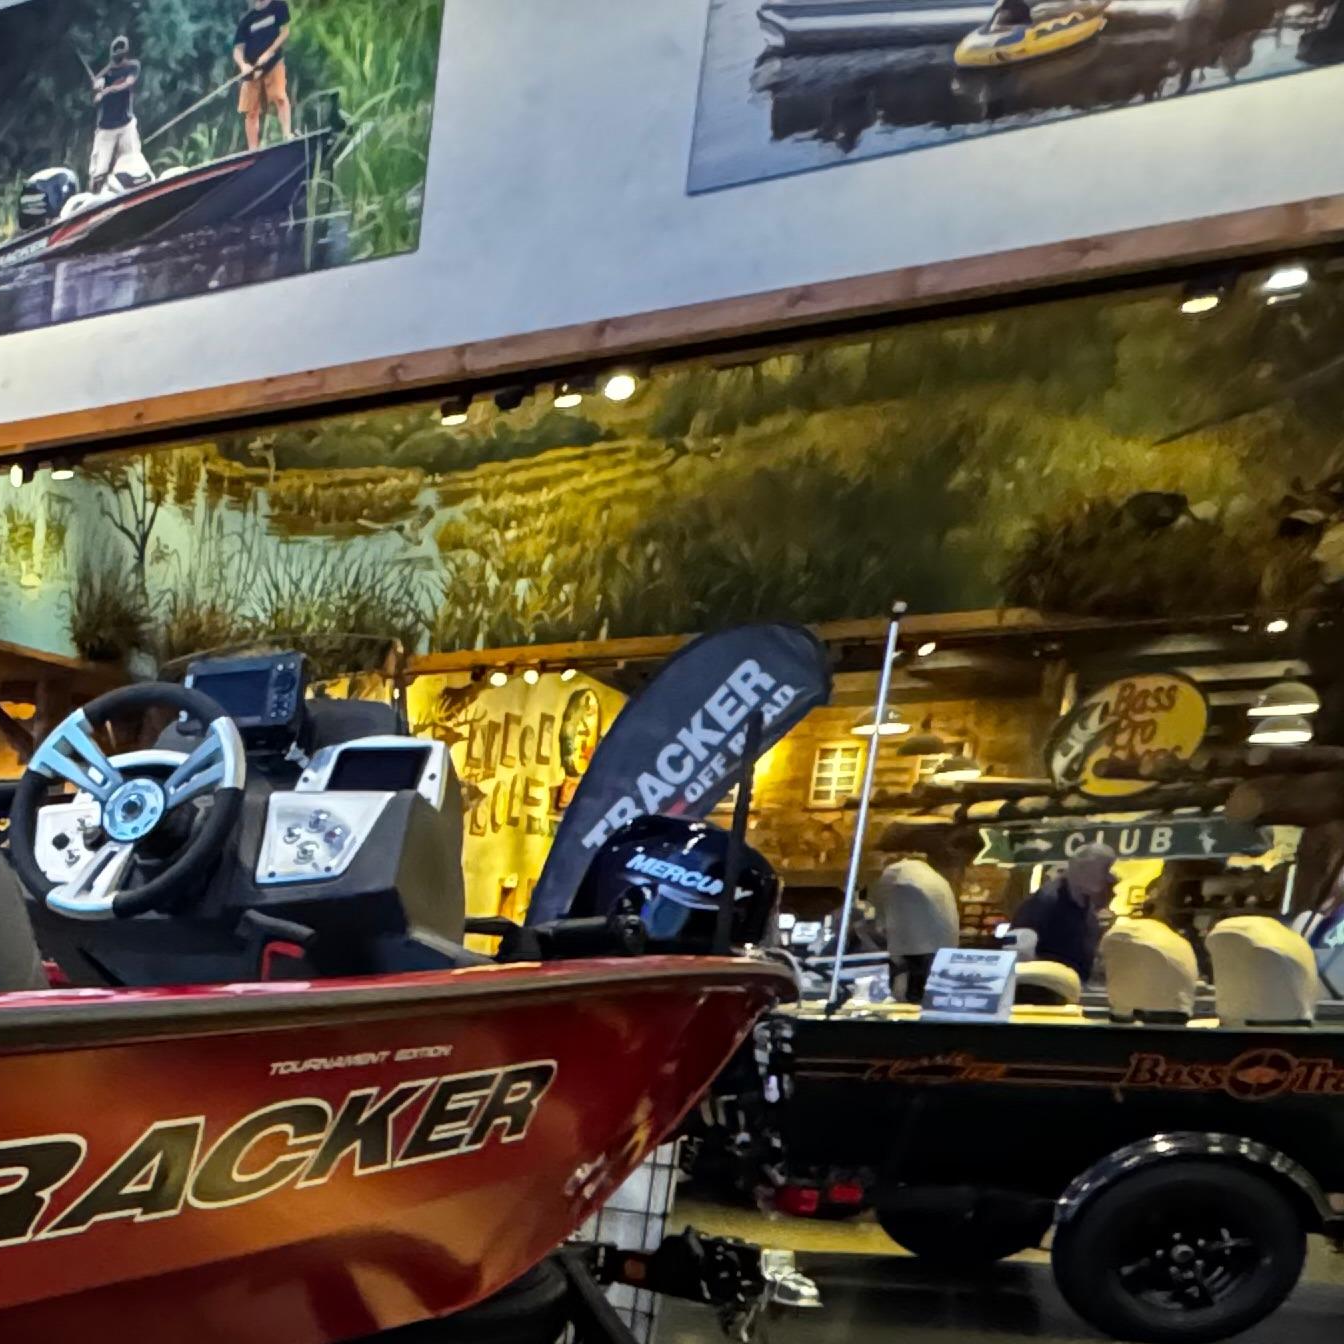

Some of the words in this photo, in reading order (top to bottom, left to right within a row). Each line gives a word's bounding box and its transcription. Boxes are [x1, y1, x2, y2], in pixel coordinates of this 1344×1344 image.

[1115, 681, 1181, 716] Bass
[581, 659, 777, 849] TRACKER
[684, 752, 728, 804] OFF
[727, 684, 797, 757] RAD
[1064, 826, 1174, 858] CLUB
[625, 853, 754, 902] MERCUY
[270, 1051, 391, 1076] TOURNAMENT
[394, 1045, 454, 1062] EDITION
[1121, 1053, 1225, 1090] Bass
